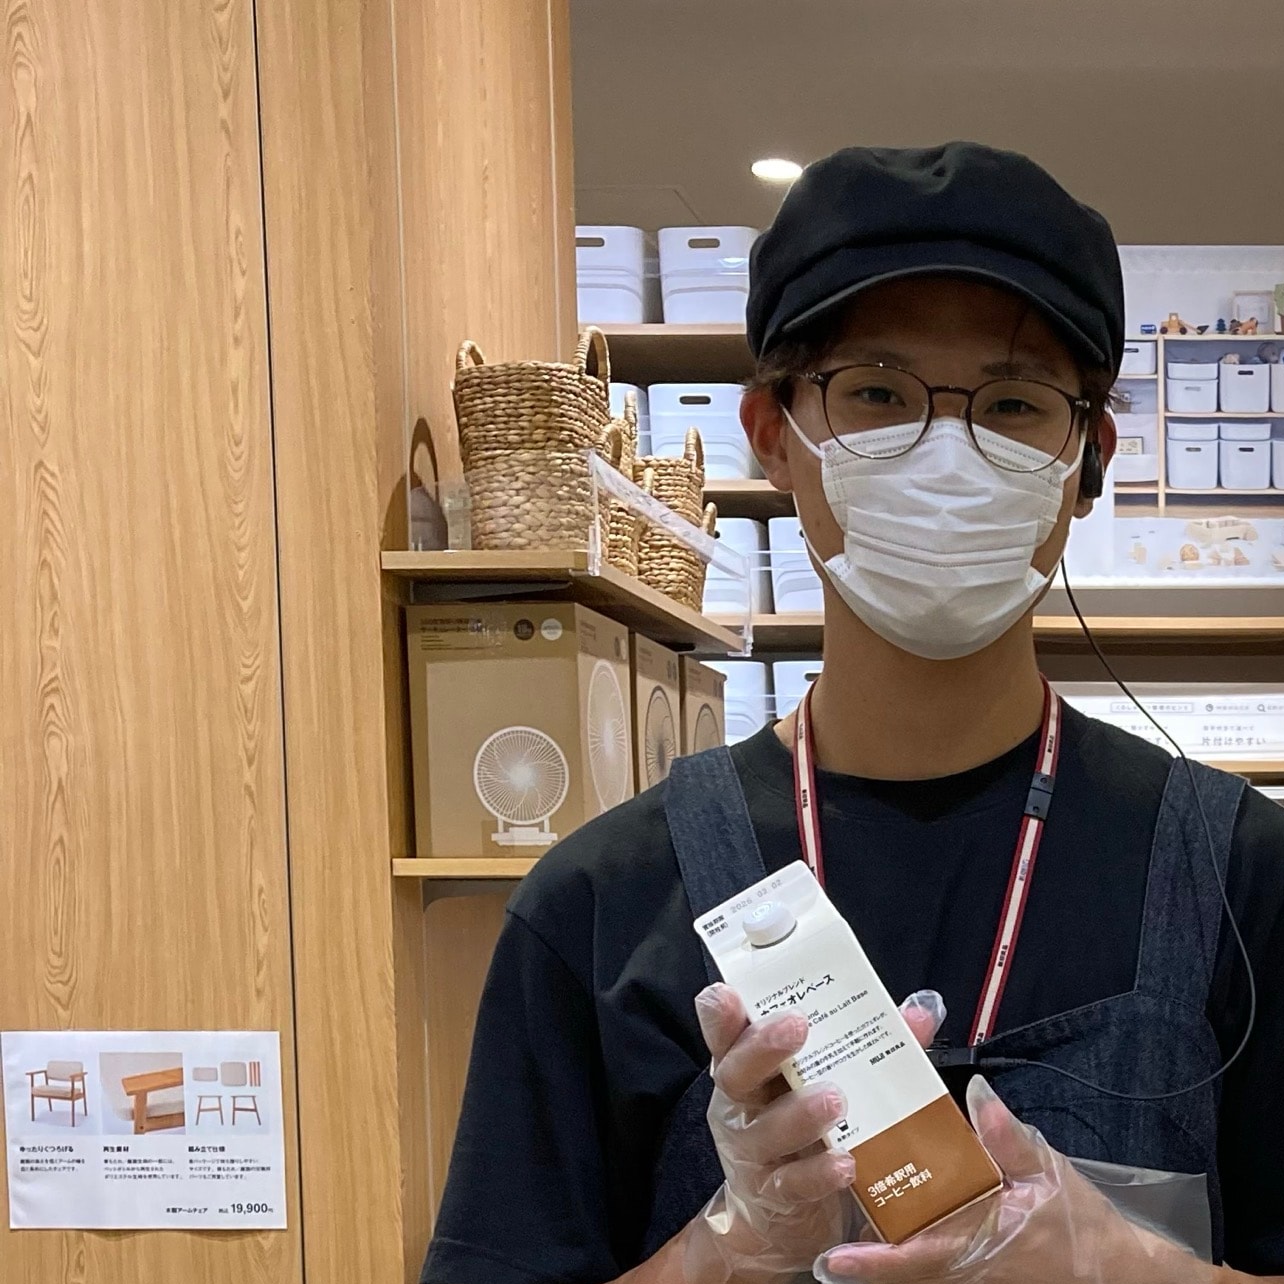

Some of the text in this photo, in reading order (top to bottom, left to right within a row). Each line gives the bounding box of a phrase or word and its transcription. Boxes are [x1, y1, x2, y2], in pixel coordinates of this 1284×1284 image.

[754, 976, 806, 1010] オリジナルブレンド
[812, 1013, 829, 1025] Café
[829, 1007, 838, 1016] au
[838, 997, 852, 1011] Lait
[851, 989, 869, 1003] Base
[19, 1145, 74, 1153] ゆったりくつろげる
[867, 1162, 917, 1198] 3倍希釈用
[873, 1168, 933, 1209] コーヒー飲料
